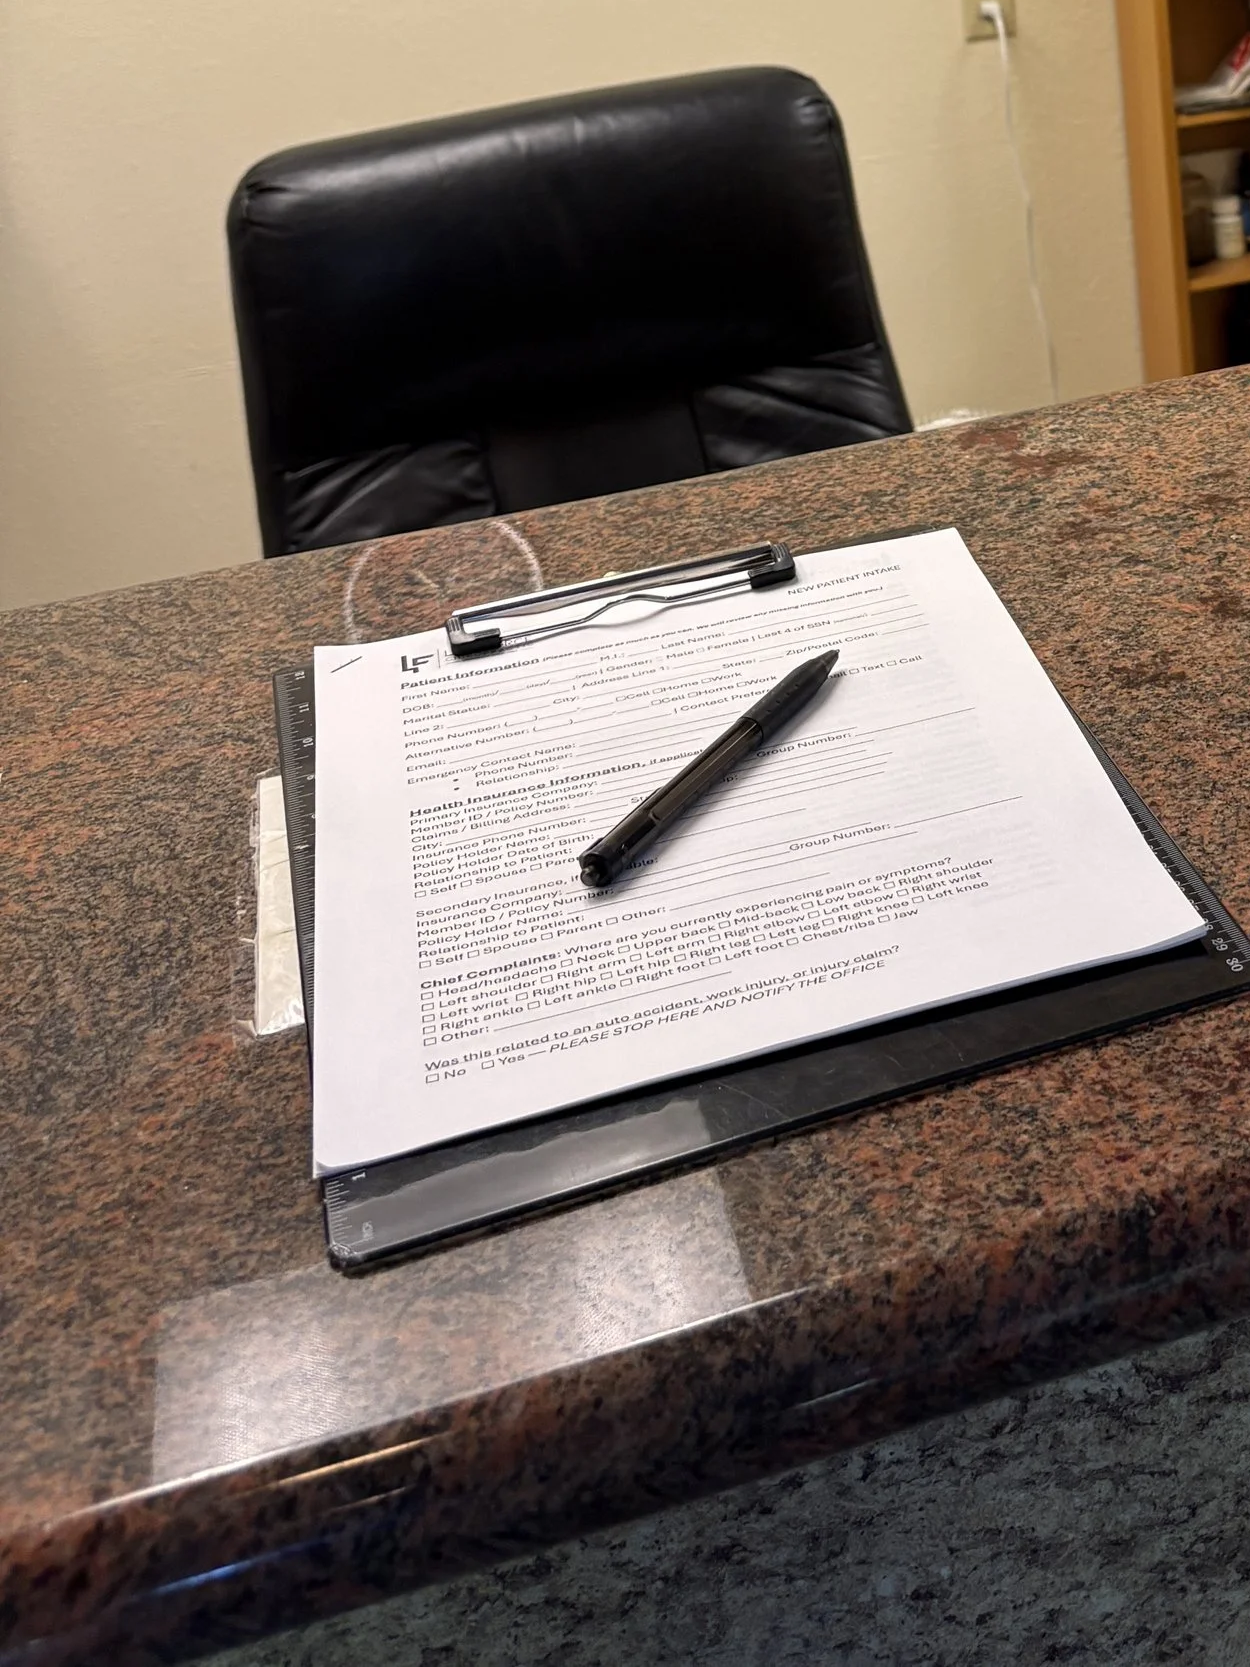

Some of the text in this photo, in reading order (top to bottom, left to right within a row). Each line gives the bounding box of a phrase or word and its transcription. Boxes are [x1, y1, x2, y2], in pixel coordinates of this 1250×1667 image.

[788, 564, 902, 596] NEW PATIENT INTAKE
[400, 657, 540, 690] Patient Information
[302, 737, 314, 748] 10
[410, 761, 646, 818] Health Insurance Information,
[789, 824, 891, 852] Group Number:
[420, 856, 953, 990] Chief Complaints: Where are you currently experiencing pain or symptoms?
[1225, 957, 1244, 973] 30
[425, 945, 900, 1071] Was this related to an auto accident, work injury, or injury claim?
[444, 960, 886, 1080] No Yes PLEASE STOP HERE AND NOTIFY THE OFFICE
